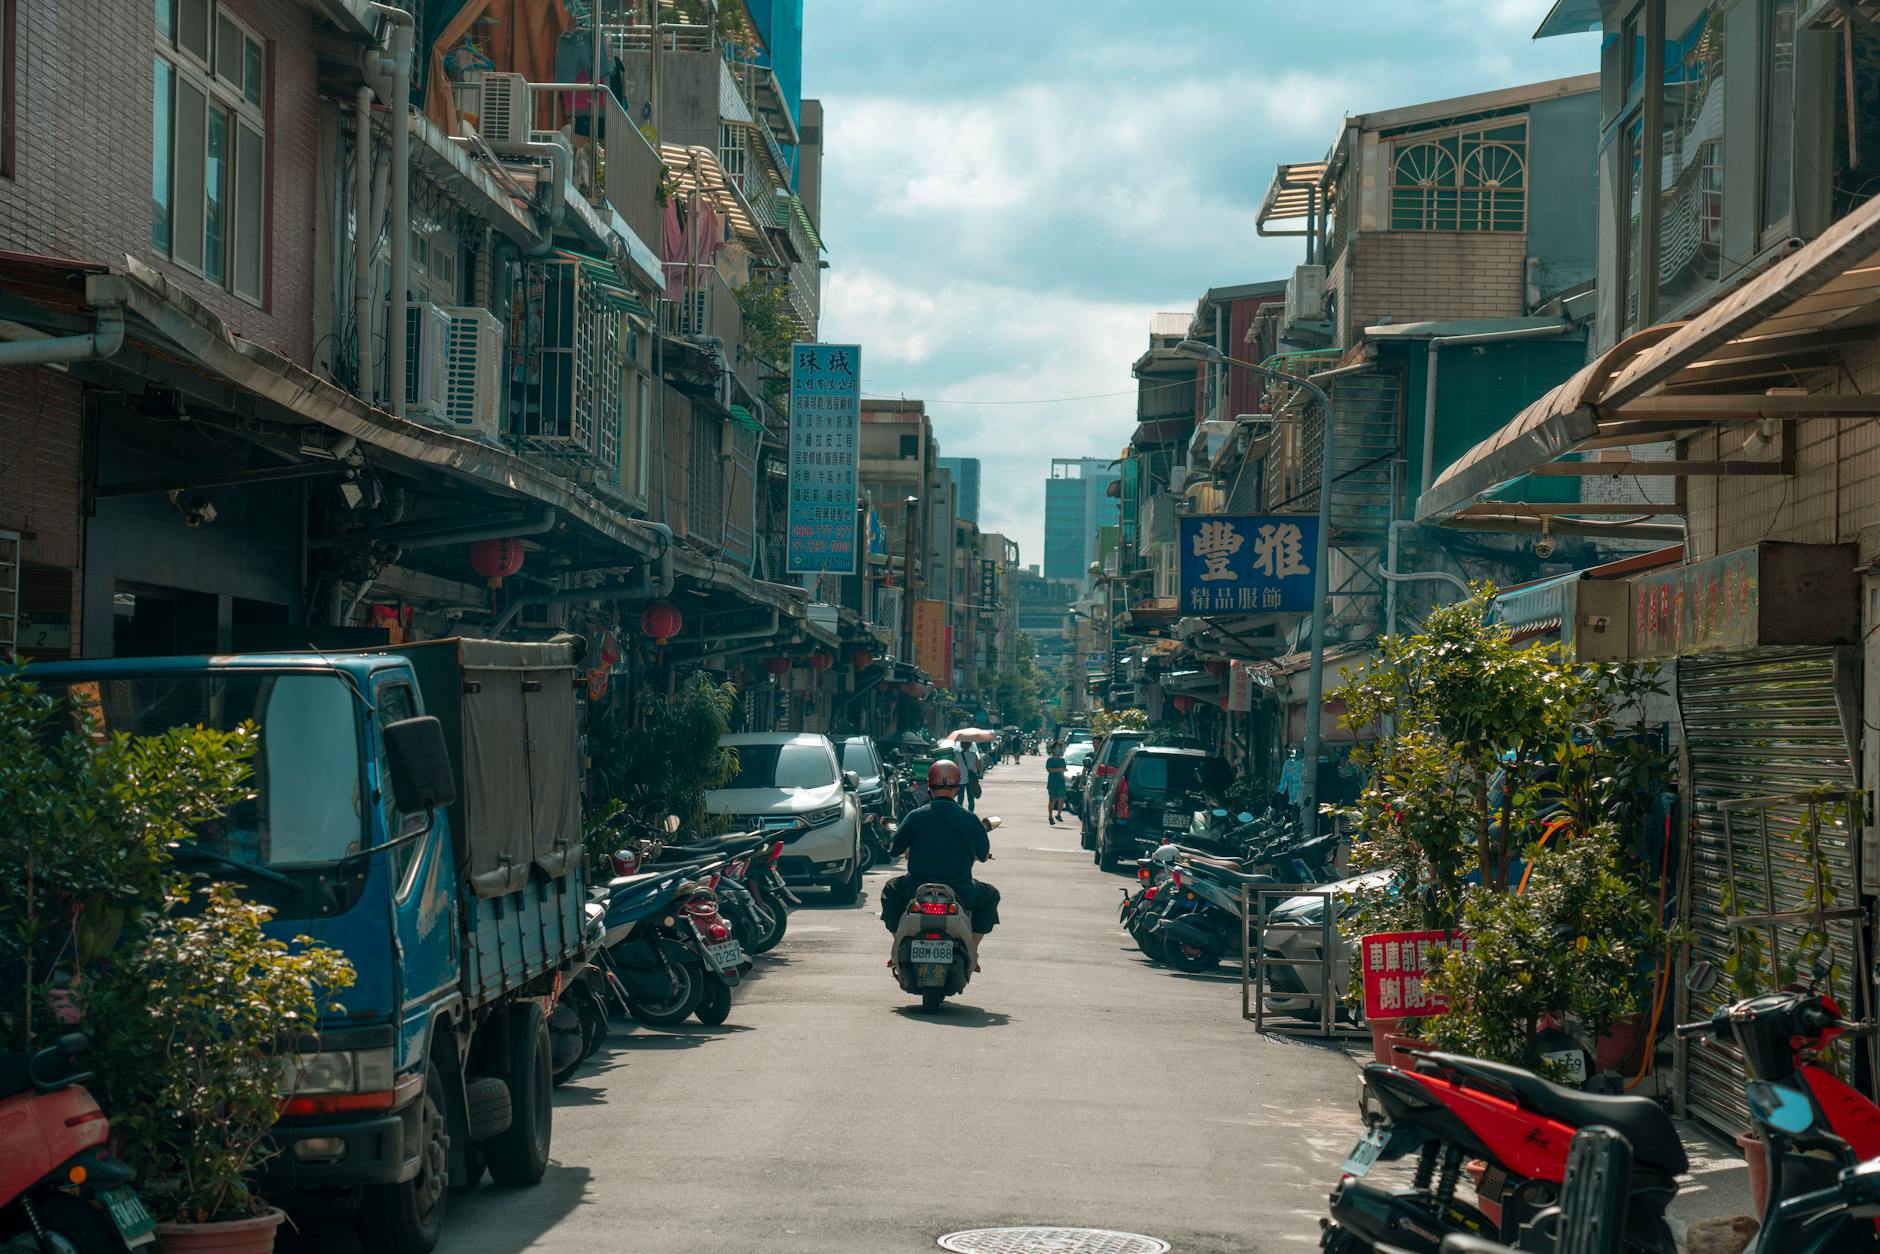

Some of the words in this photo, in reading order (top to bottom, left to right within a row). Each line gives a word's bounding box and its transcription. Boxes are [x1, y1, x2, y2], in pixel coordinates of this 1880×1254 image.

[796, 378, 856, 391] 工程有限公司
[1192, 521, 1310, 582] 豐雅
[1190, 586, 1282, 609] 精品服飾
[36, 631, 47, 646] 2
